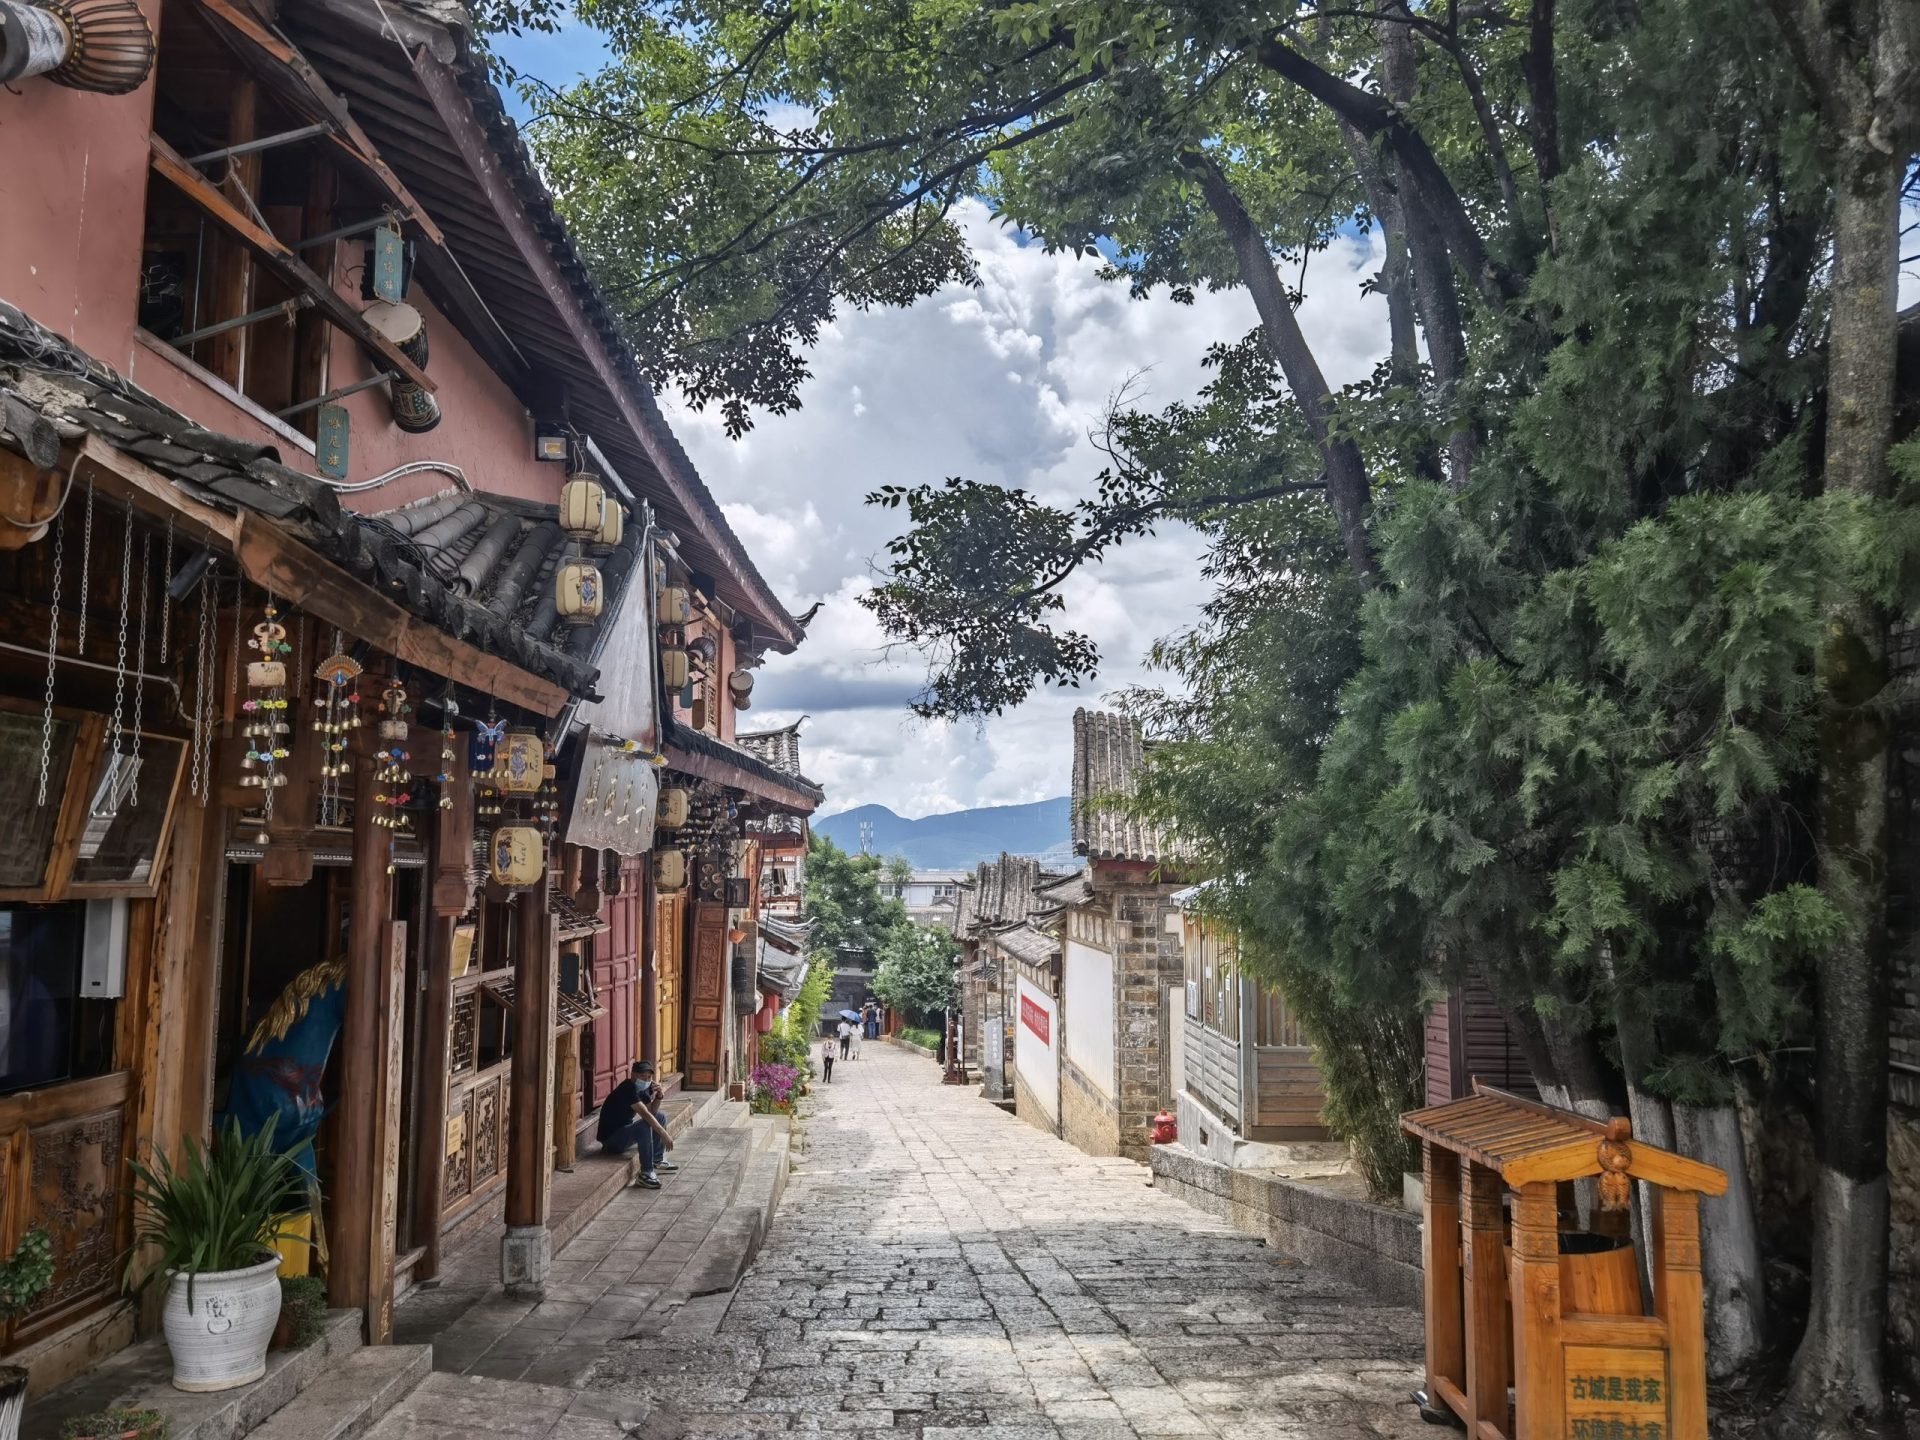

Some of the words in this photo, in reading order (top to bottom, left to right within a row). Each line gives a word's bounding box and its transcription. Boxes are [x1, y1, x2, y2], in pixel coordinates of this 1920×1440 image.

[1569, 1374, 1662, 1404] 古城是我家
